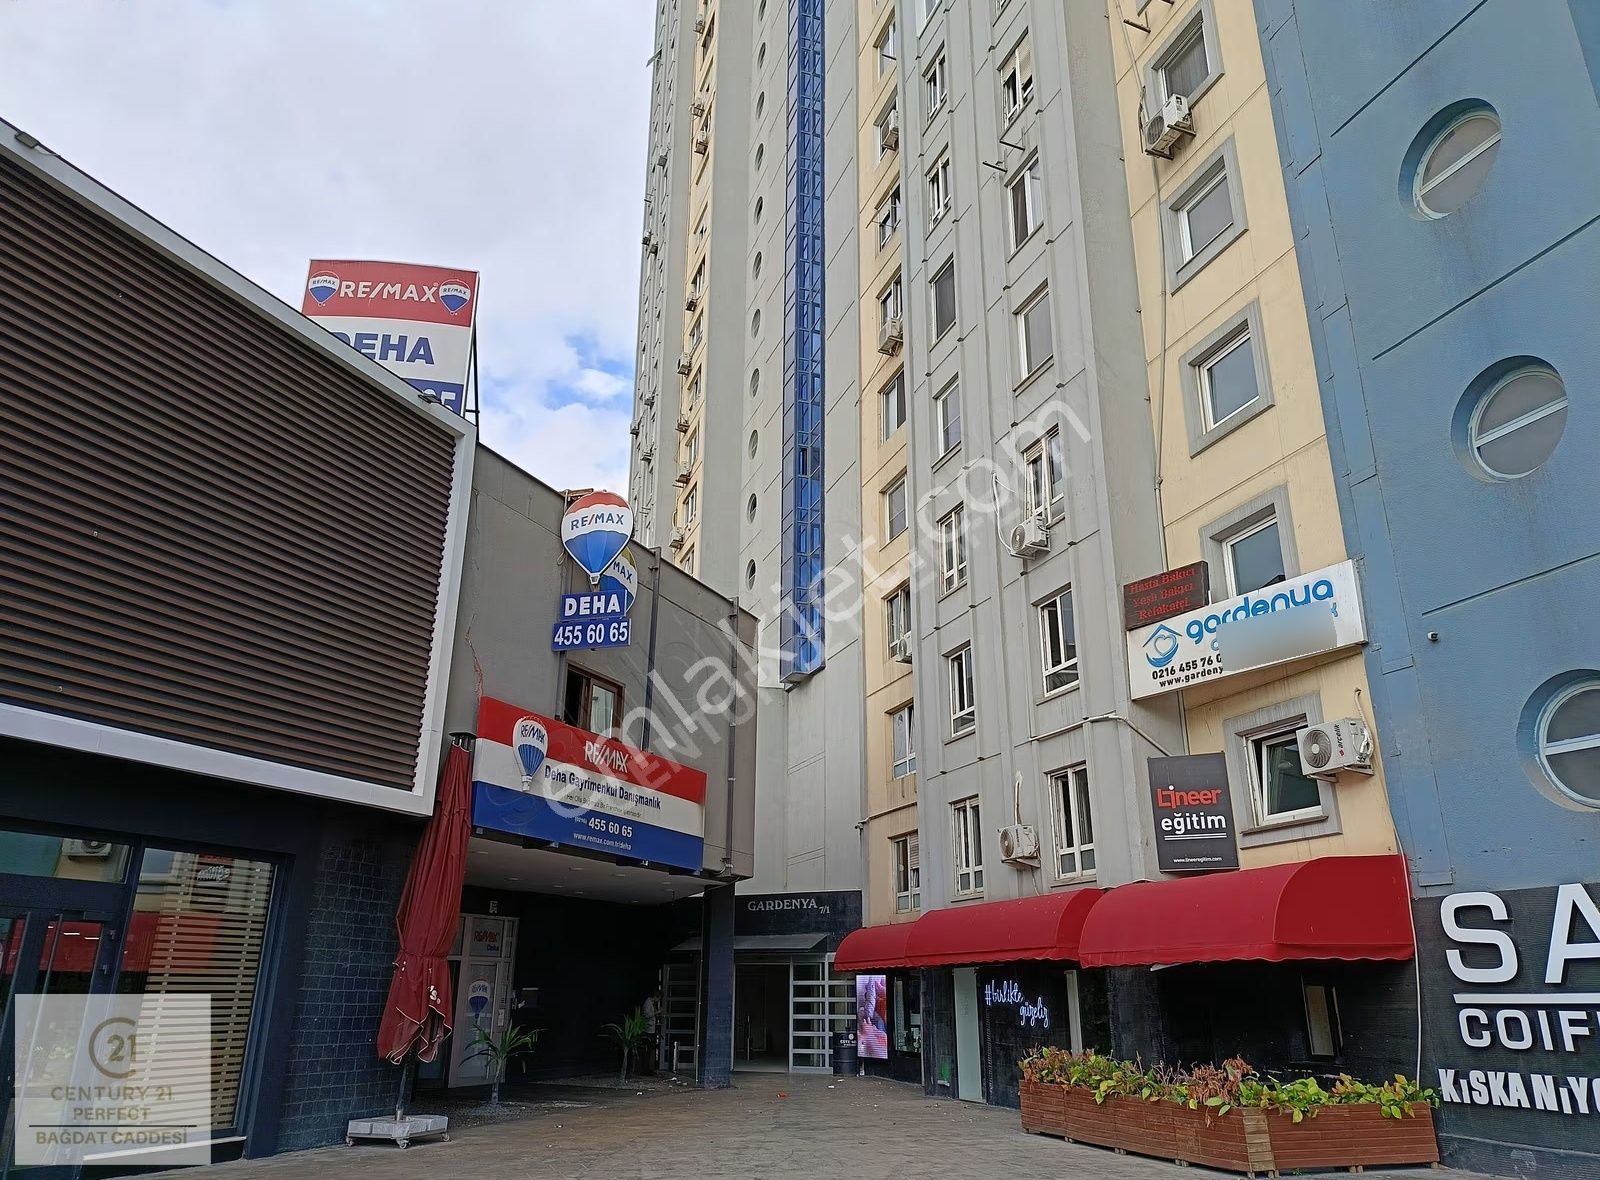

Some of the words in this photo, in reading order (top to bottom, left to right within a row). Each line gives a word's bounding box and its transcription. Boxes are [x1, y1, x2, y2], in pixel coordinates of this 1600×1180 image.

[339, 281, 438, 303] RE/MAX
[570, 512, 625, 531] RE/MAX
[564, 593, 621, 617] DEHA
[553, 625, 582, 646] 455
[586, 623, 605, 644] 60
[609, 621, 628, 642] 65
[1152, 666, 1176, 680] 0216
[1179, 660, 1198, 673] 455
[1200, 656, 1213, 667] 76
[584, 741, 628, 772] RE/MAX
[544, 765, 567, 785] Deha
[619, 786, 661, 810] Danışmanlık
[1156, 785, 1222, 809] Lineer
[588, 817, 606, 832] 455
[608, 821, 620, 835] 60
[621, 824, 633, 838] 65
[1161, 812, 1227, 835] eğitim
[747, 898, 818, 912] GARDENYA
[984, 980, 1024, 1006] #birlikte
[1458, 1008, 1600, 1052] COIF
